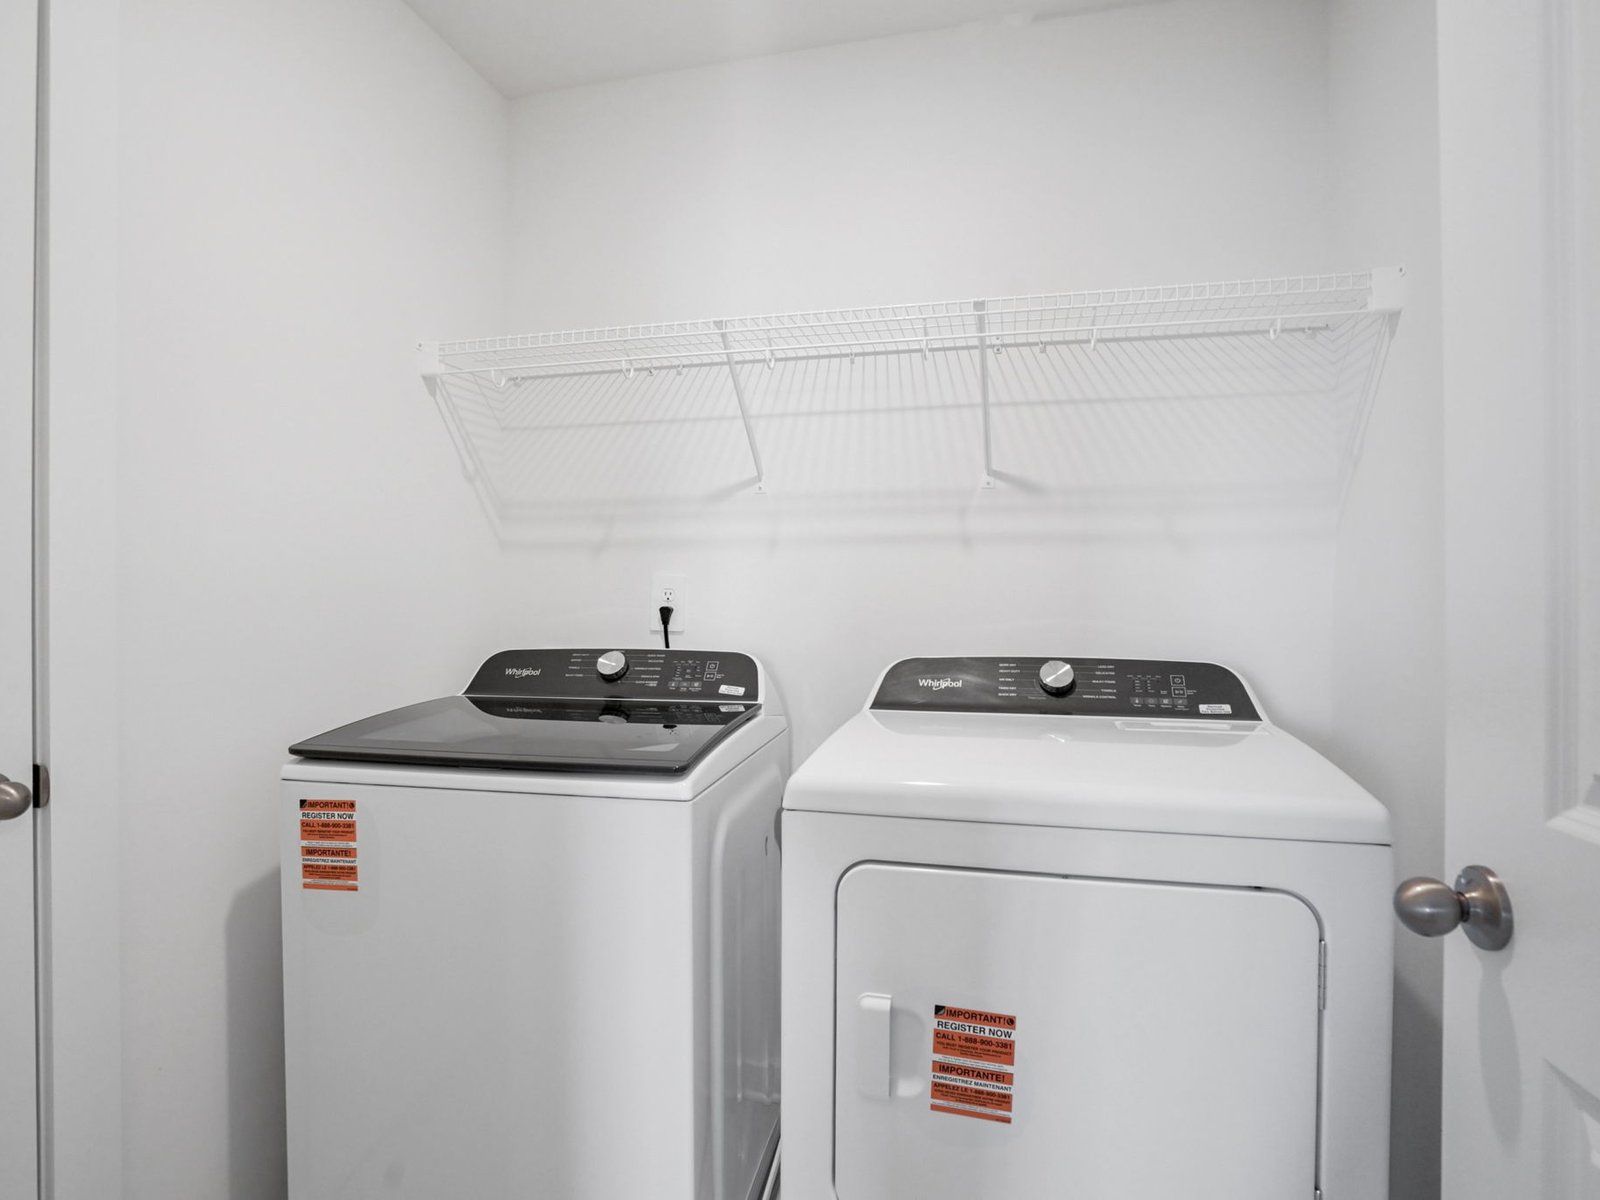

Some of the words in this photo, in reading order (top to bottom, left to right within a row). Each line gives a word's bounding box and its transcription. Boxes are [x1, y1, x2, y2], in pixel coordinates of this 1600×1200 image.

[505, 667, 541, 679] Whirlpool
[918, 678, 962, 690] Whirlpool
[946, 1009, 1006, 1025] IMPORTANT!
[937, 1020, 986, 1035] REGISTER
[988, 1028, 1012, 1039] NOW
[935, 1032, 956, 1041] CALL
[957, 1036, 1012, 1050] 1-888-900-3381
[938, 1064, 1005, 1083] IMPORTANTE!
[932, 1074, 973, 1086] ENREGISTREZ
[973, 1081, 1012, 1092] MAINTENANT
